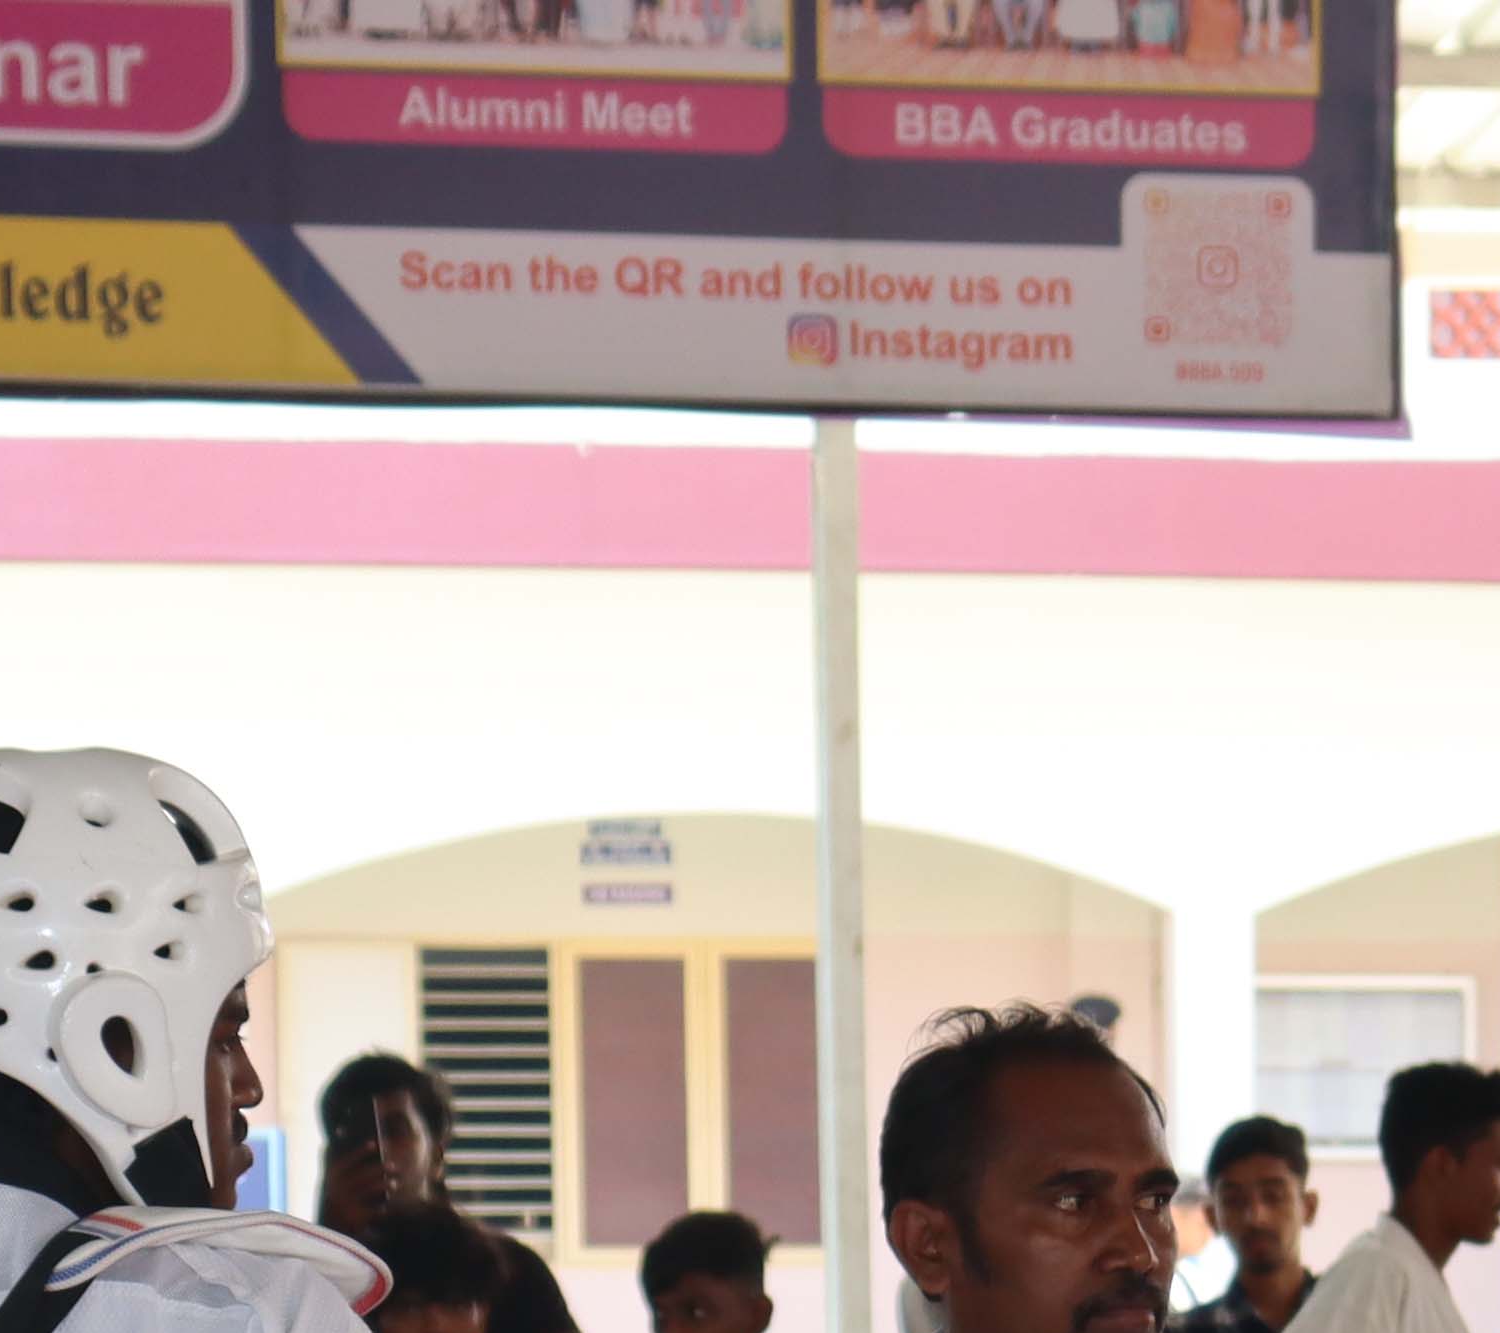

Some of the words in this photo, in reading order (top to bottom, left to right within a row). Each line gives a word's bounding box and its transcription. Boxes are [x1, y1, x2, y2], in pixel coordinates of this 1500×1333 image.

[399, 85, 566, 134] Alumni
[582, 92, 694, 137] Meet
[894, 101, 998, 147] BBA
[1010, 106, 1248, 154] Graduates
[399, 250, 512, 292] Scan
[527, 254, 598, 293] the
[614, 256, 684, 297] QR
[699, 262, 783, 301] and
[798, 262, 934, 305] follow
[949, 276, 1000, 305] us
[1016, 278, 1073, 306] on
[849, 320, 1073, 370] Instagram
